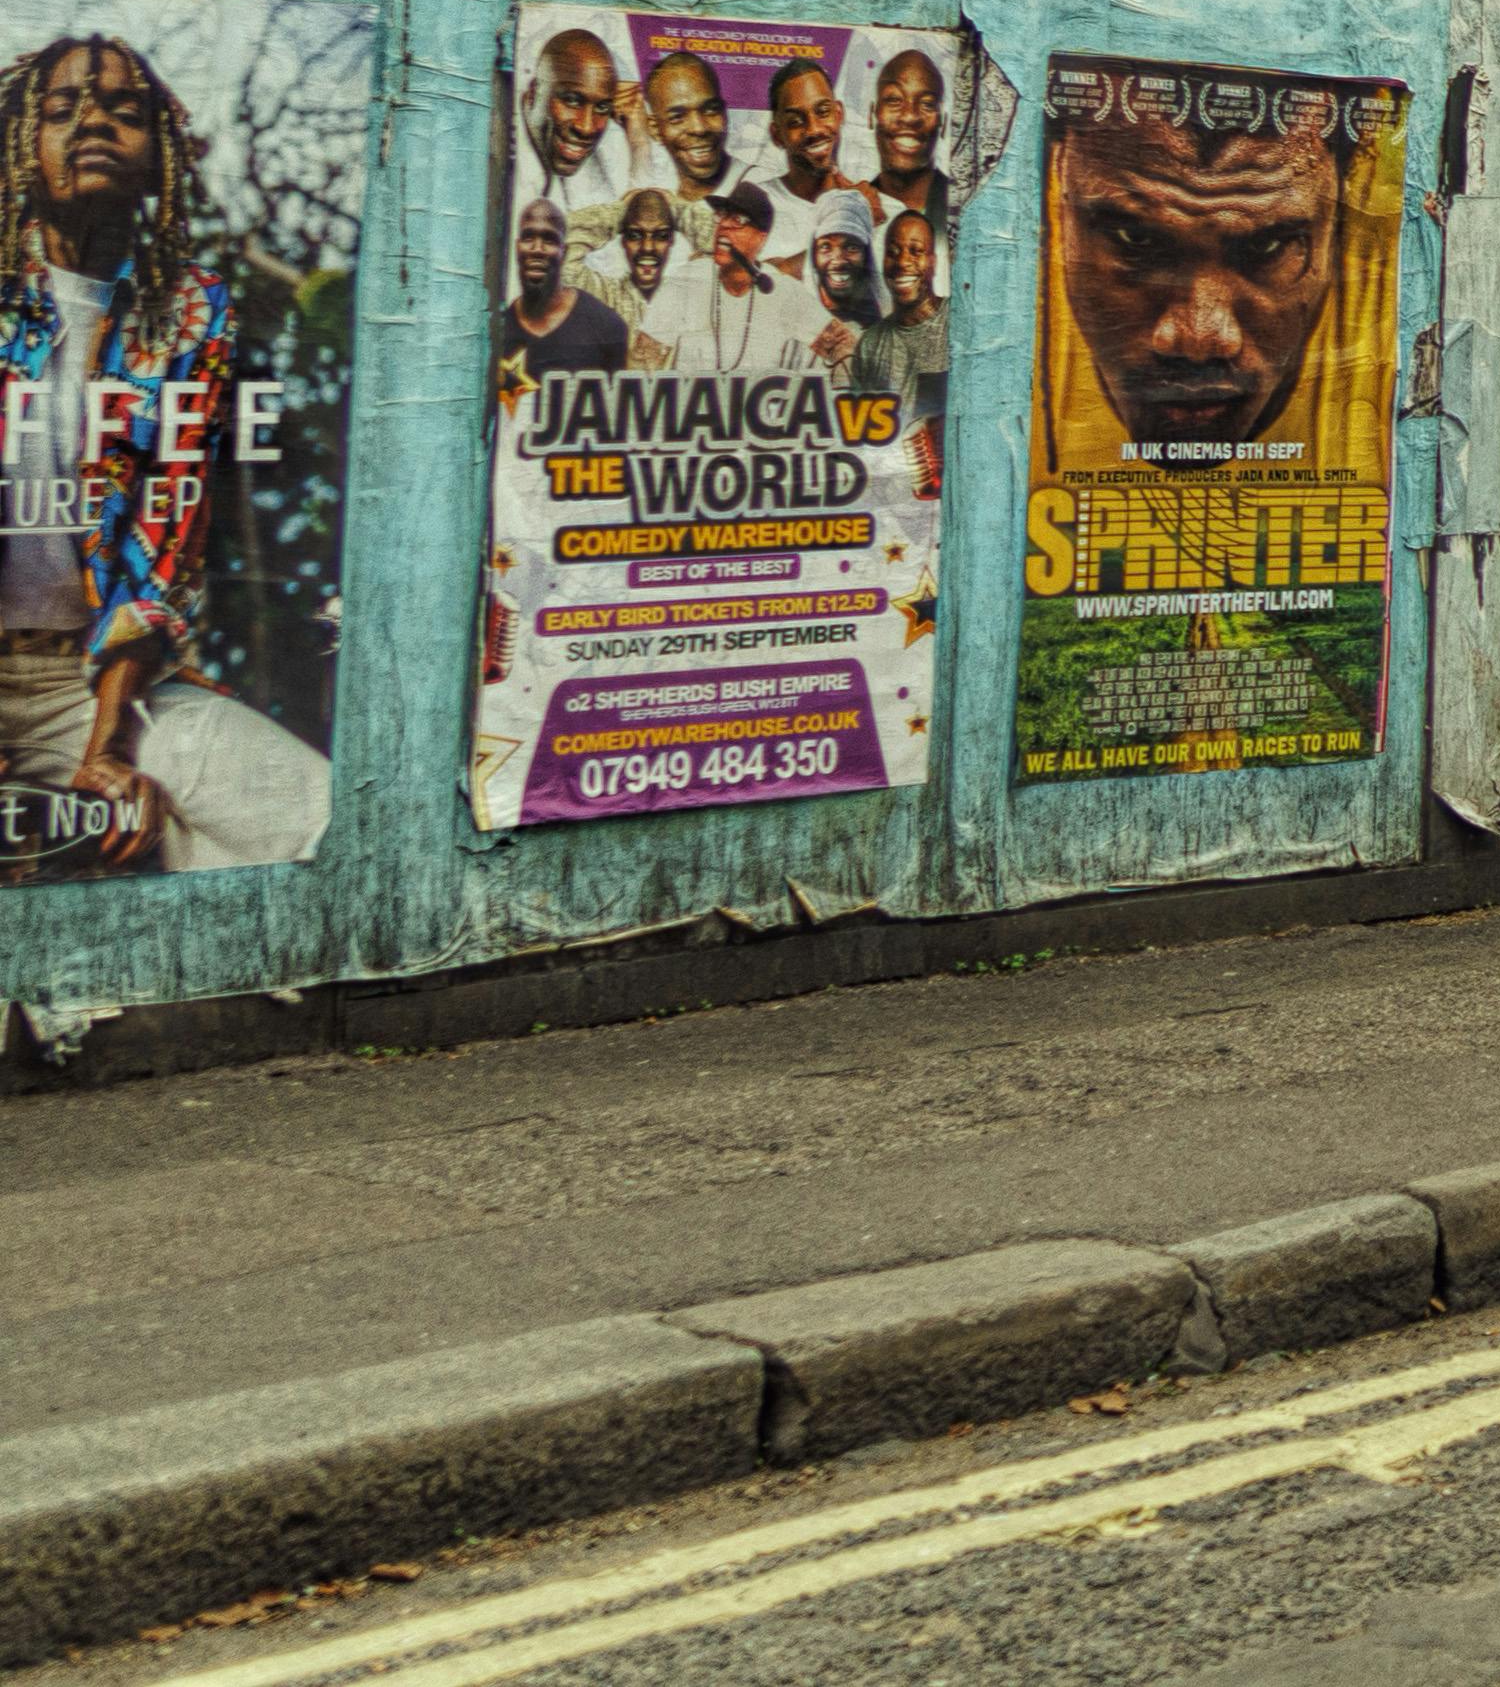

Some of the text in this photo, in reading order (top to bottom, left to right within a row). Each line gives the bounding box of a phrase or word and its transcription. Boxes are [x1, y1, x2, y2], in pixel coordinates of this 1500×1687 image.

[529, 373, 898, 448] JAMAICA VS
[1121, 442, 1305, 461] IN UK CINEMAS 6TH SEPT
[546, 451, 869, 516] THE WORLD
[1063, 468, 1358, 485] FROM EXECUTIVE PRODUCERS JADA AND WILL SMITH
[143, 476, 203, 524] EP
[560, 517, 872, 559] COMEDY WAREHOUSE
[1025, 486, 1390, 597] SPRINTER
[638, 558, 794, 583] BEST OF THE BEST
[544, 592, 877, 632] EARLY BIRD TICKETS FROM £12.50
[1075, 588, 1334, 619] WWW.SPRINTERTHEFILM.COM
[566, 622, 858, 663] SUNDAY 29TH SEPTEMBER
[593, 672, 852, 710] SHEPHERDS BUSH EMPIRE
[552, 709, 861, 756] COMEDYWAREHOUSE.CO.UK
[1026, 731, 1362, 775] WE ALL HAVE OUR OWN RACES TO RUN
[578, 736, 840, 800] 07949 484 350
